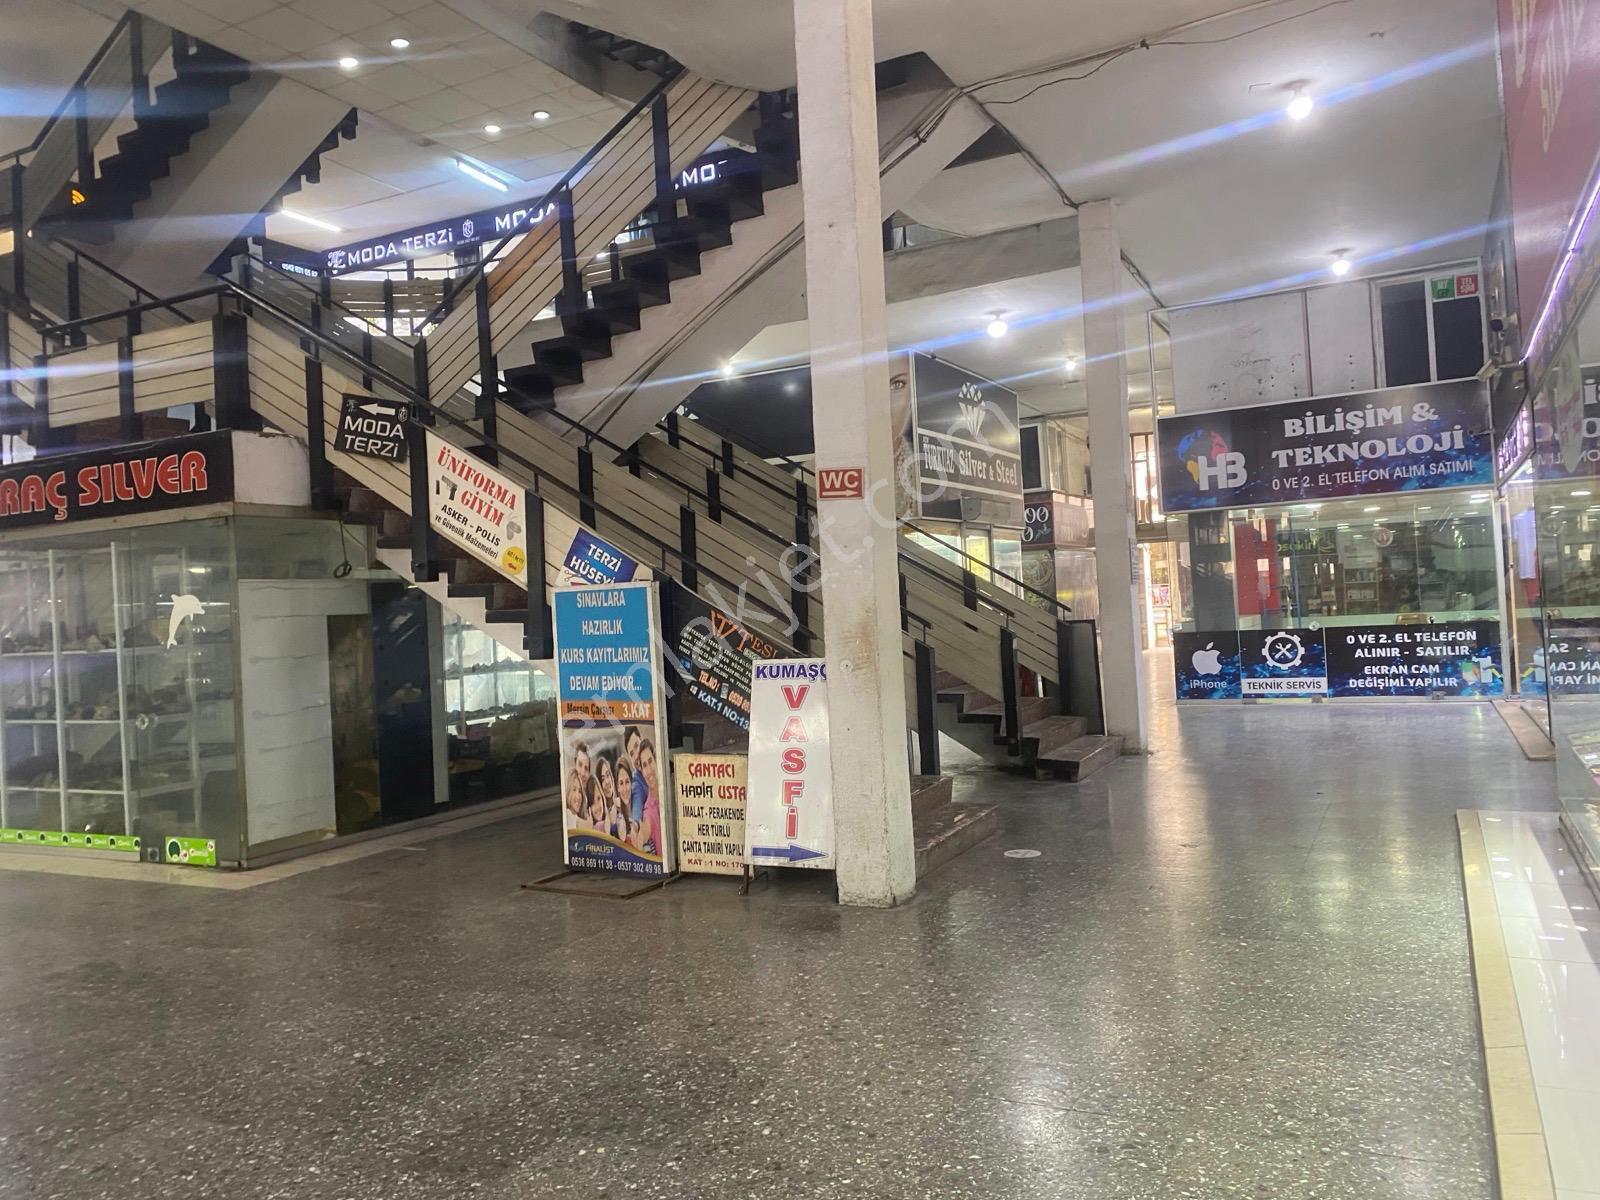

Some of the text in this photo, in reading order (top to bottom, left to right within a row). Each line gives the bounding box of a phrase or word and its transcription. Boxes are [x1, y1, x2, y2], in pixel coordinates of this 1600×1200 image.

[348, 242, 397, 266] MODA
[344, 415, 404, 440] MODA
[1283, 402, 1440, 437] BİLİŞİM &
[1271, 424, 1465, 468] TEKNOLOJİ
[959, 449, 987, 480] Silver
[995, 459, 1018, 486] Steel
[1198, 451, 1248, 491] HB
[1283, 476, 1298, 489] VE
[1302, 475, 1315, 488] 2.
[1318, 473, 1332, 486] EL
[1335, 466, 1389, 484] TELEFON
[1393, 463, 1426, 479] ALIM
[1429, 458, 1474, 475] SATIMI
[78, 451, 208, 507] SILVER
[437, 446, 517, 510] ÜNİFORMA
[821, 470, 859, 489] WC
[460, 490, 506, 528] GİYİM
[441, 504, 469, 526] ASKER
[475, 525, 501, 547] POLİS
[442, 517, 465, 538] Güvenlik
[465, 532, 499, 560] Malzemeleri
[588, 543, 622, 573] TERZİ
[576, 591, 626, 608] SINAVLARA
[582, 619, 623, 635] HAZIRLIK
[1358, 634, 1376, 644] VE
[1379, 633, 1392, 644] 2.
[1395, 632, 1412, 643] EL
[1414, 630, 1477, 642] TELEFON
[560, 647, 649, 664] KURS KAYITLARIMIZ
[1355, 648, 1401, 658] ALINIR
[1416, 645, 1470, 657] SATILIR
[1364, 664, 1440, 675] EKRAN CAM
[570, 675, 599, 691] DEVAM
[1190, 679, 1228, 689] iPhone
[1247, 678, 1322, 690] TEKNİK SERVİS
[1349, 676, 1458, 690] DEĞİŞİMİ YAPILIR
[567, 703, 589, 714] Mersin
[622, 703, 650, 718] 3.KAT
[688, 763, 735, 780] ÇANTACI
[718, 785, 747, 802] USTA
[682, 803, 704, 818] İMALAT
[709, 807, 744, 821] PERAKENDE
[697, 822, 731, 838] HER TÜRLÜ
[682, 840, 702, 856] ÇANTA
[703, 840, 724, 855] TAMİRİ
[688, 858, 702, 866] KAT
